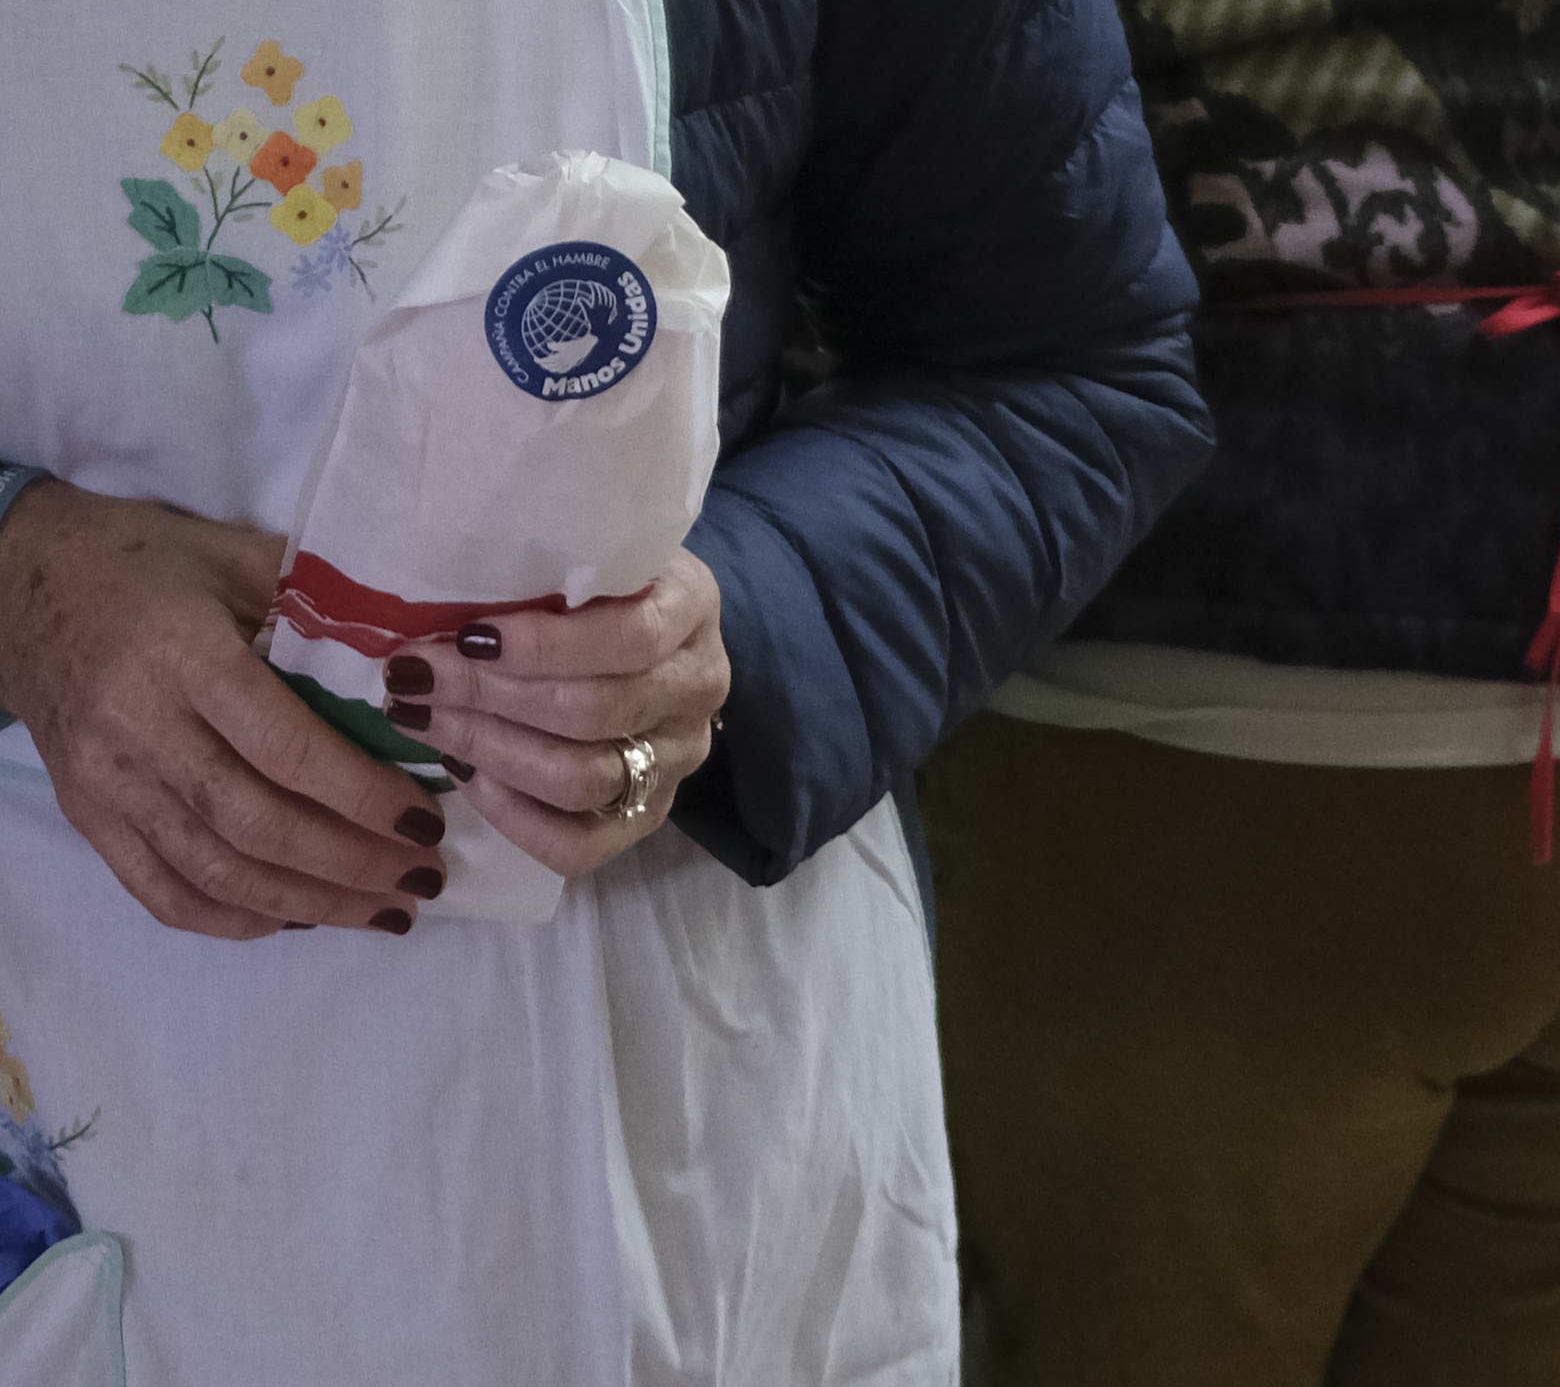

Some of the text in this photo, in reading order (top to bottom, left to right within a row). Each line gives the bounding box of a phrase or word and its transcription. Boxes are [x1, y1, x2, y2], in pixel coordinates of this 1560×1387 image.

[492, 253, 611, 383] CAMPAÑA CONTRA EL HAMBRE
[542, 271, 649, 396] Manos Unidas
